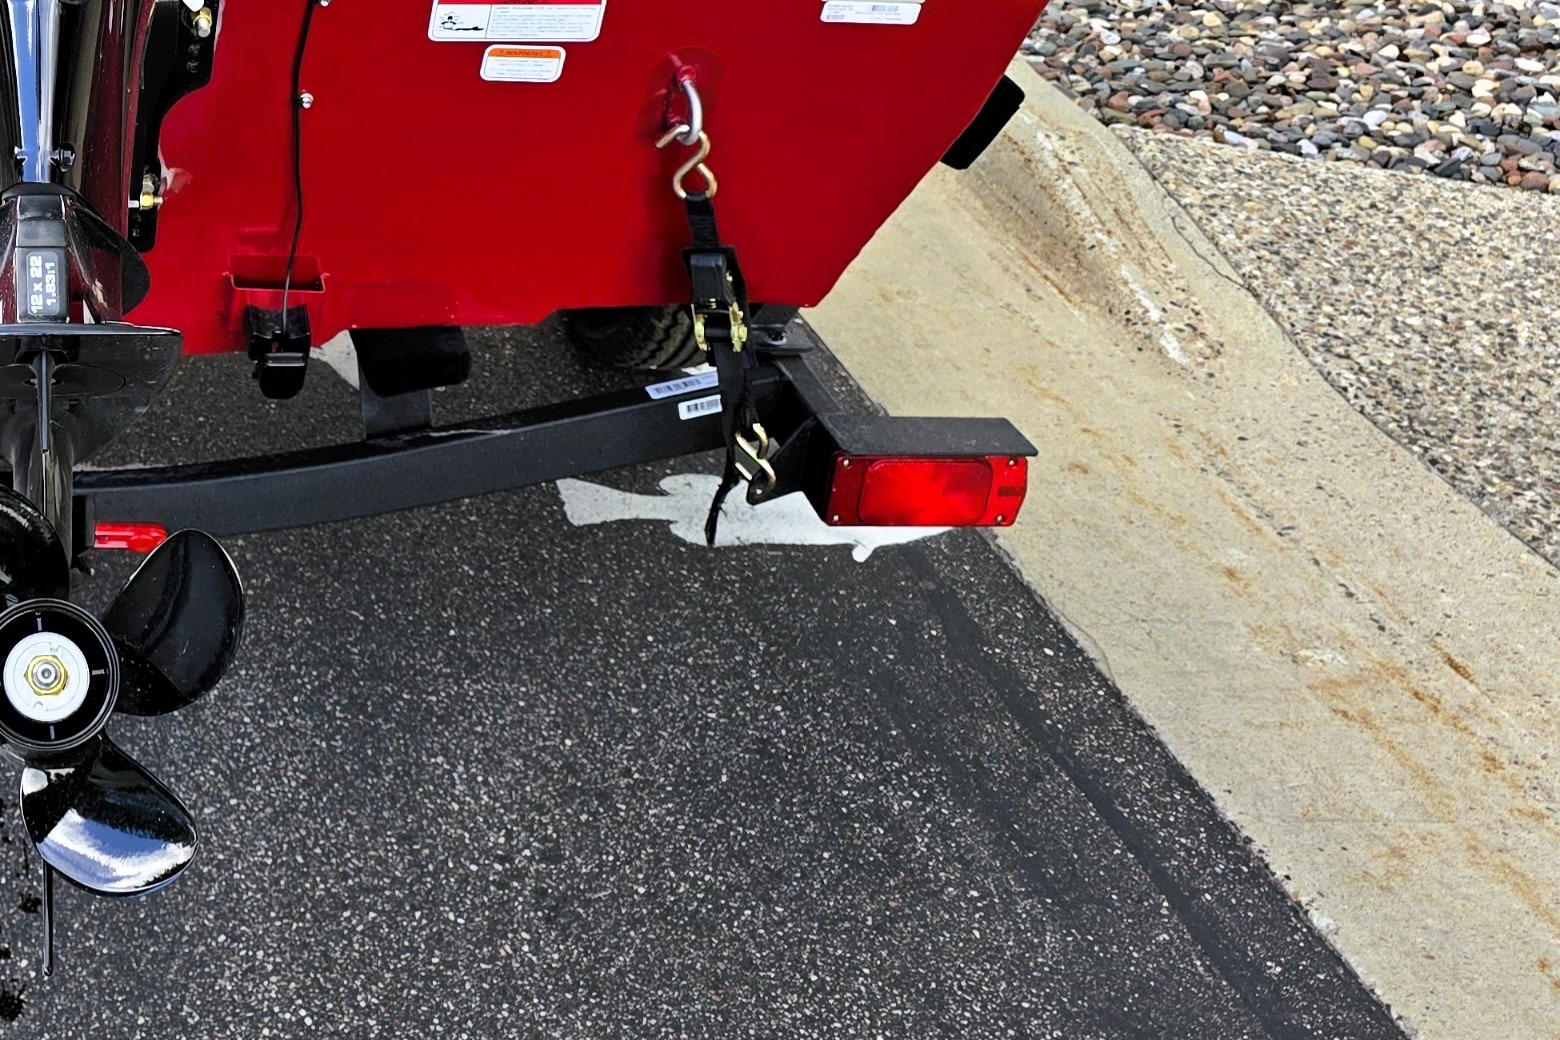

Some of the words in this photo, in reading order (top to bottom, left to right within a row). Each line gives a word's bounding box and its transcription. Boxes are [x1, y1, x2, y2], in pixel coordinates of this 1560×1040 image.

[30, 255, 42, 278] 22
[45, 262, 56, 306] 1.83:1
[30, 293, 43, 314] 12
